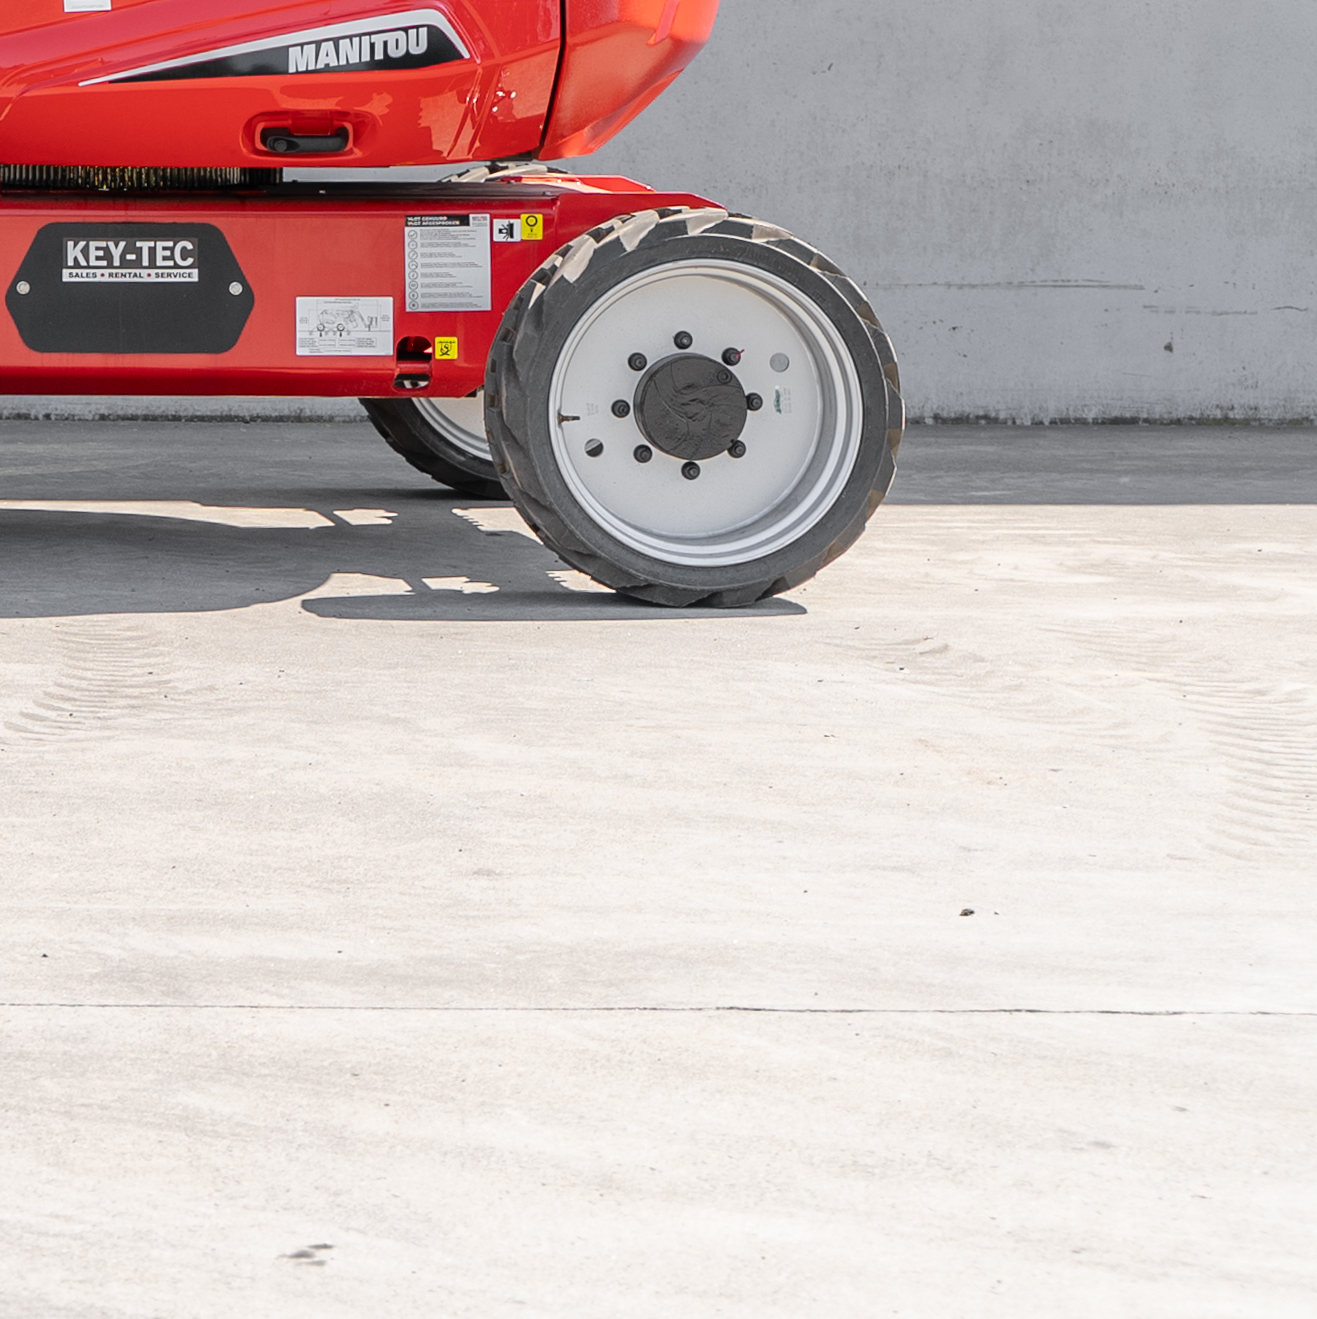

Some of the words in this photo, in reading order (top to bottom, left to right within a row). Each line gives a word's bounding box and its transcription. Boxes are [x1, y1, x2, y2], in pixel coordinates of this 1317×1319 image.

[288, 26, 428, 74] MANITOU
[66, 240, 195, 267] KEY-TEC
[68, 271, 97, 279] SALES
[108, 271, 144, 279] RENTAL
[154, 271, 194, 279] SERVICE
